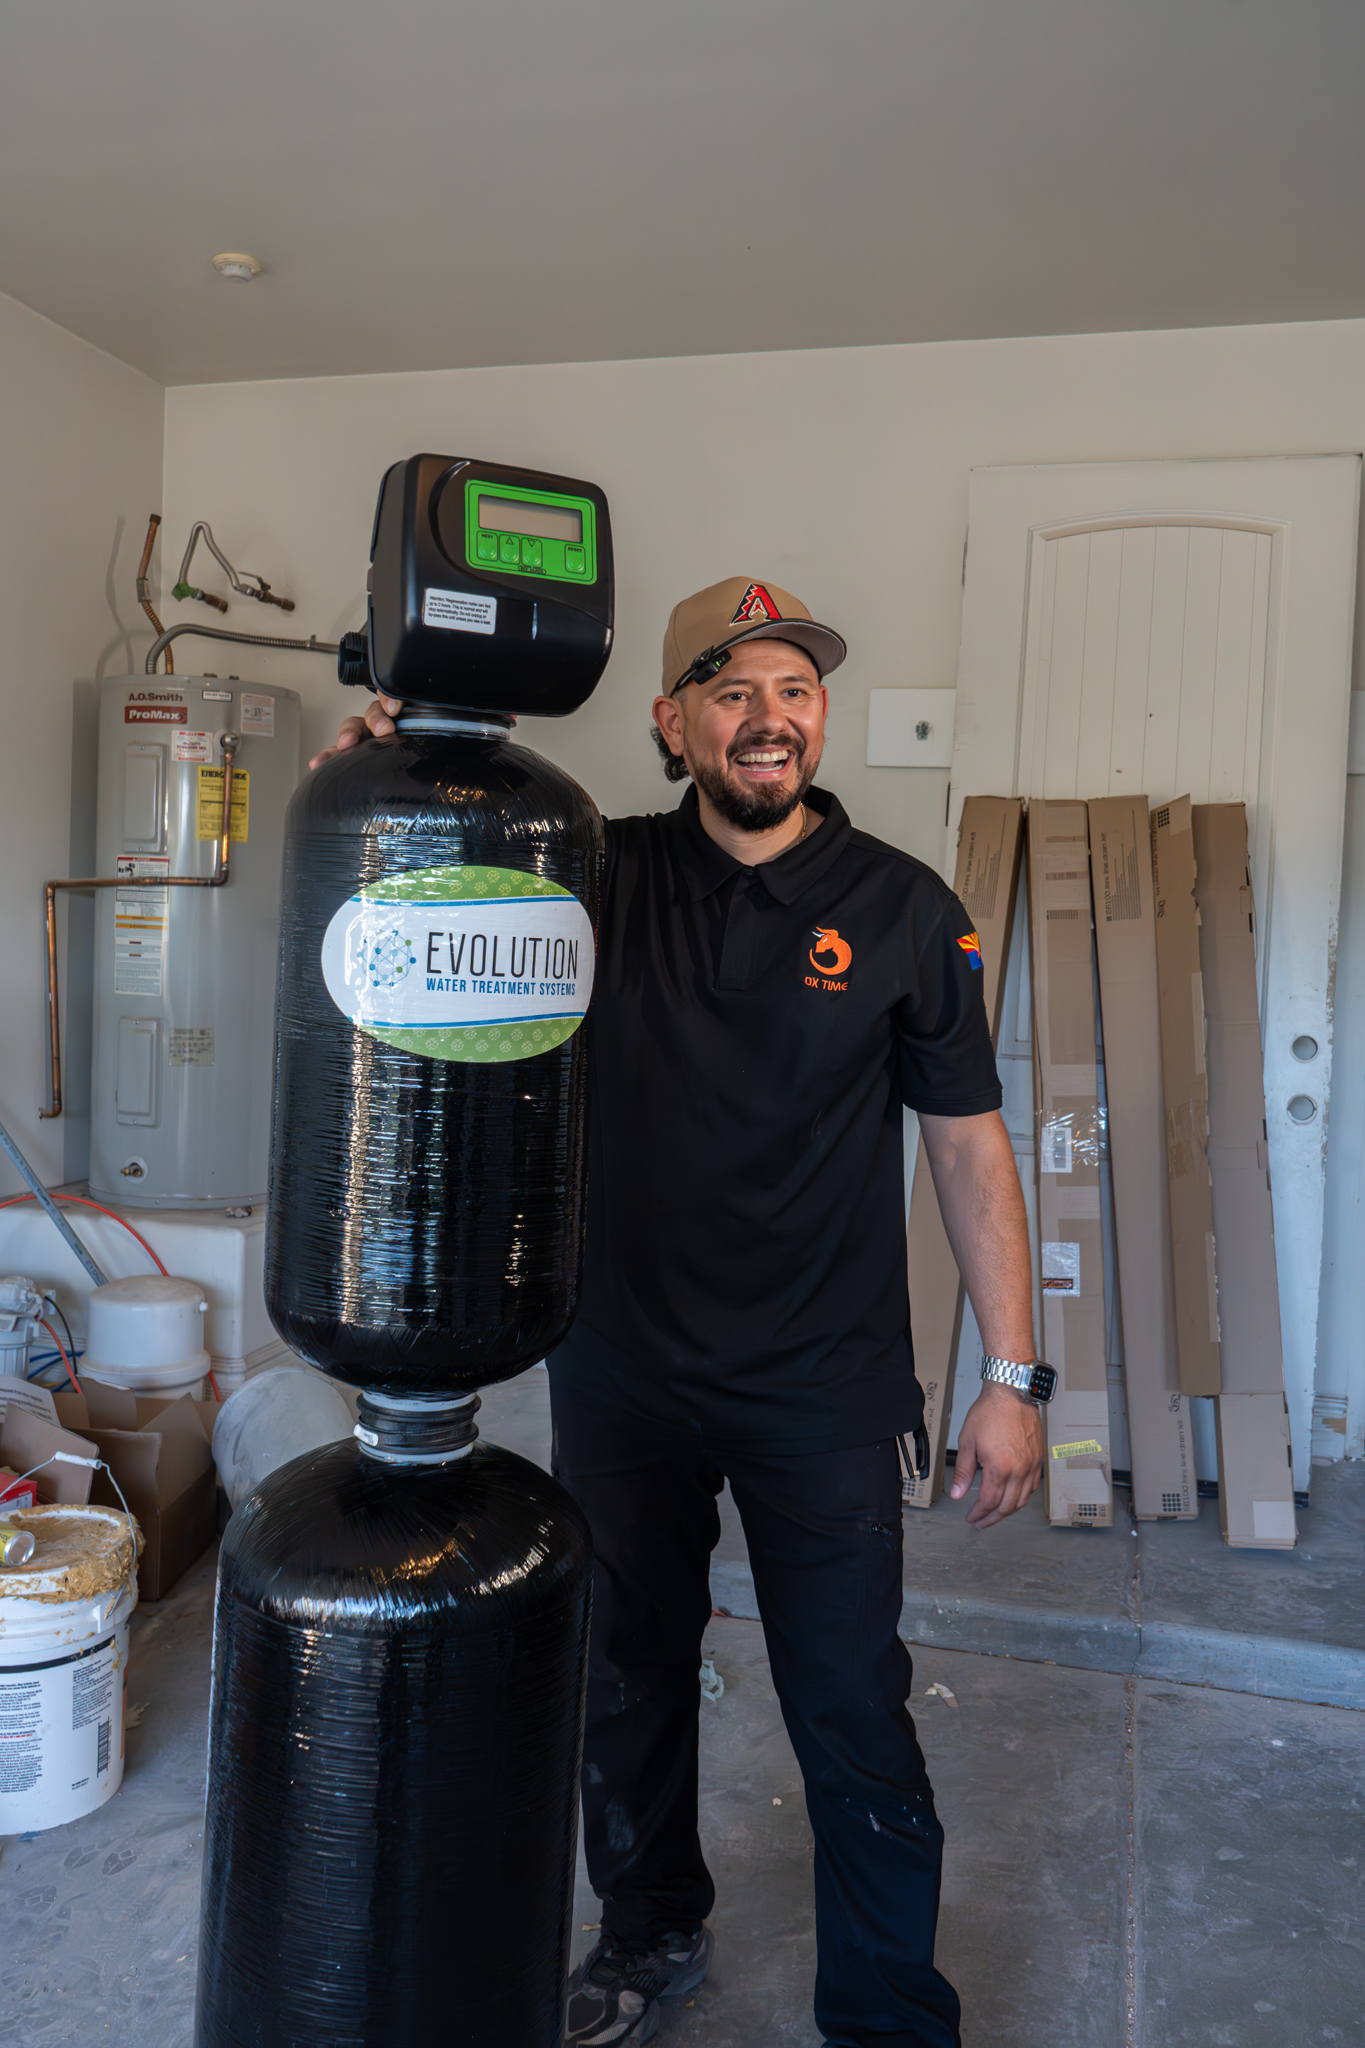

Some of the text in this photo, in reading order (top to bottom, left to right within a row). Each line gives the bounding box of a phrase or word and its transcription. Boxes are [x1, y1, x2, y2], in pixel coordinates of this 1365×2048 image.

[129, 709, 181, 720] ProMax
[201, 770, 247, 781] ENERGUIDE
[426, 931, 578, 980] EVOLUTION
[426, 977, 576, 996] WATER TREATMENT SYSTEMS
[804, 976, 849, 992] OX TIME
[1178, 1431, 1186, 1452] drain
